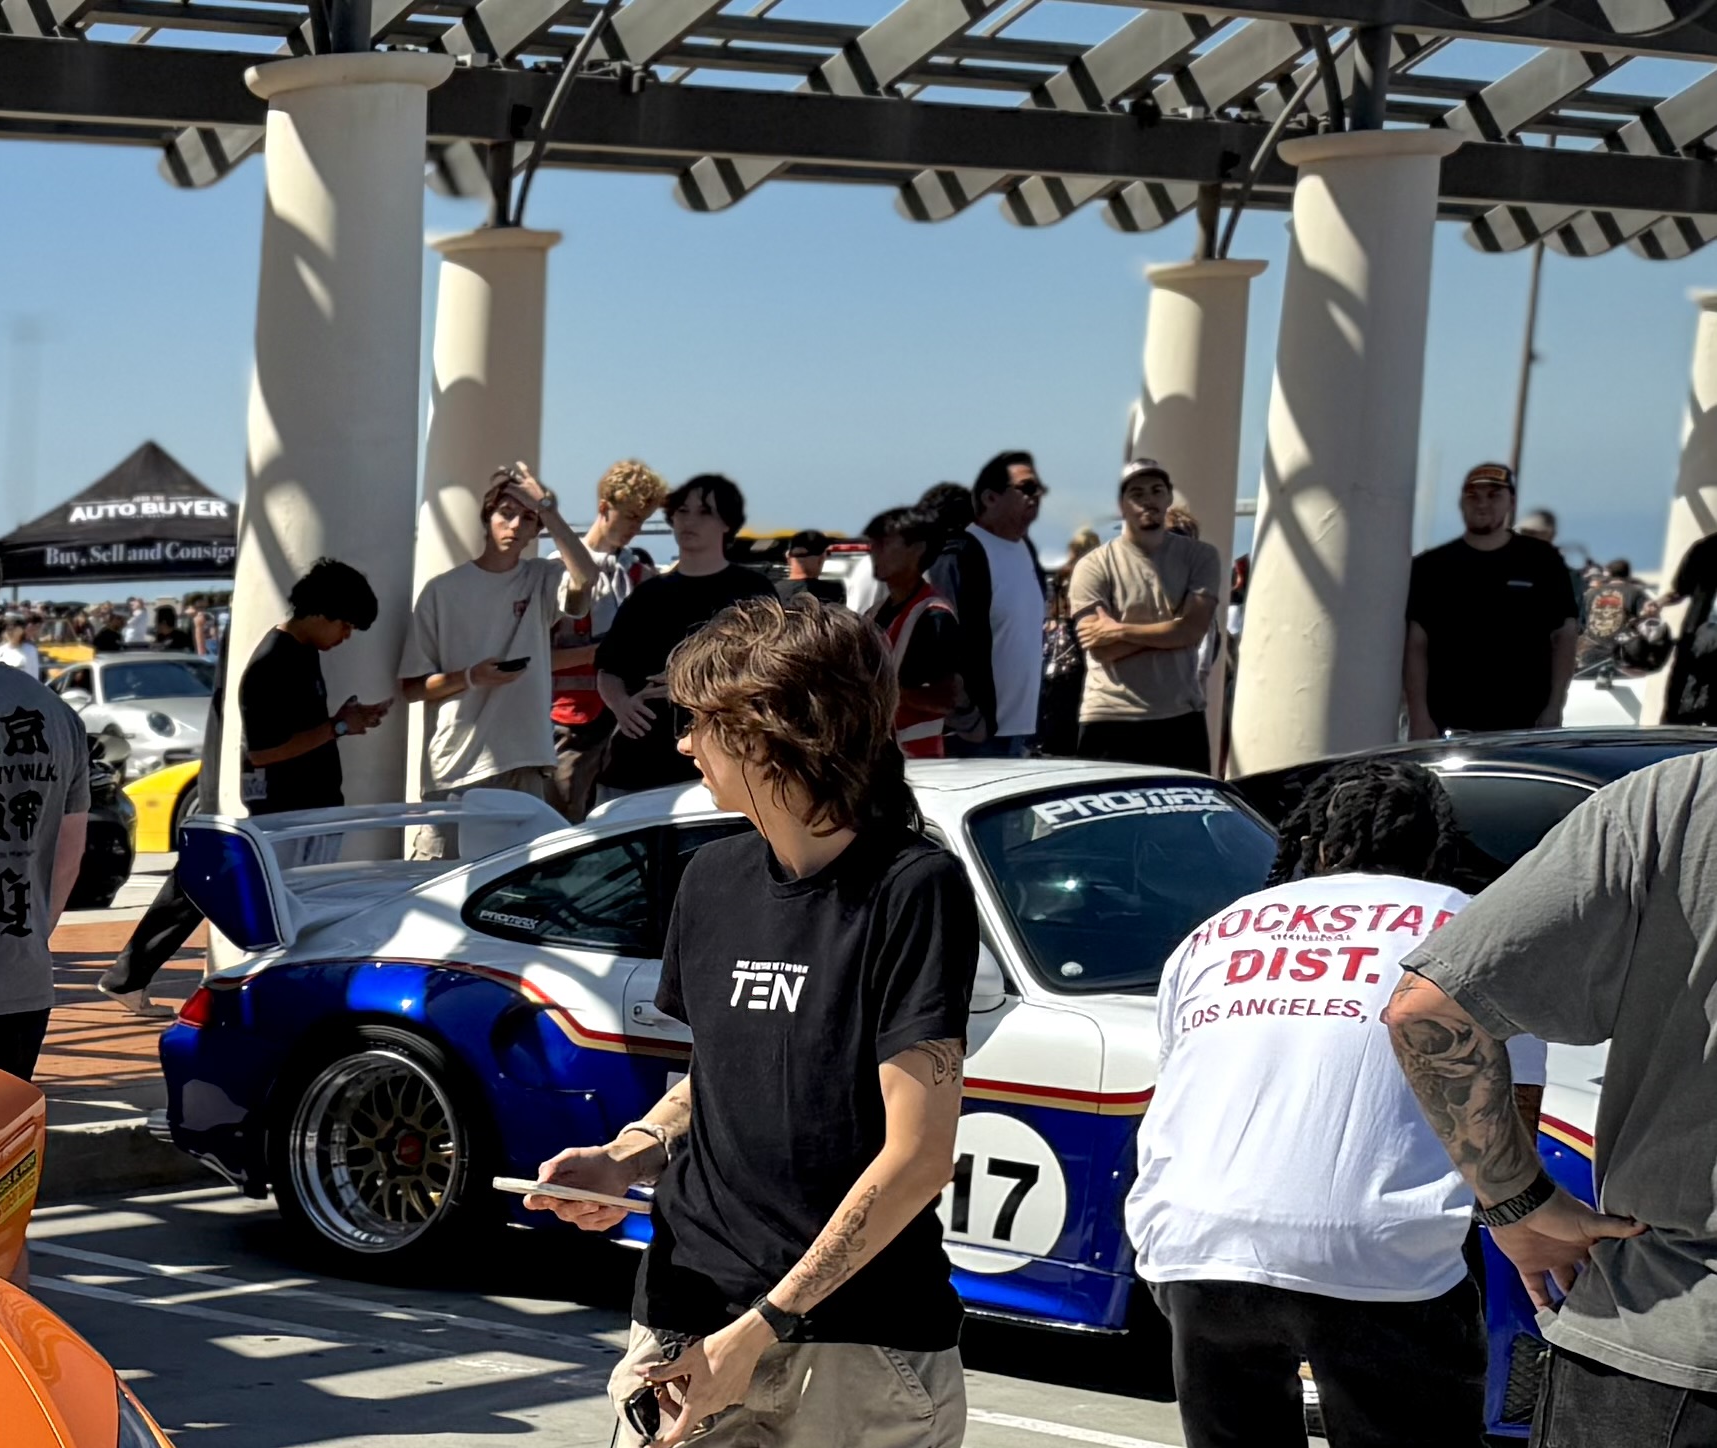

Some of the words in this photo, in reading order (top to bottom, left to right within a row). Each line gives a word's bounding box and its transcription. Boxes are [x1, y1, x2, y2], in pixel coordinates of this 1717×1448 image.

[69, 503, 137, 523] AUTO
[140, 501, 228, 518] BUYER
[90, 543, 124, 562] Sell
[127, 542, 163, 562] and
[1223, 946, 1381, 986] DIST.
[730, 969, 806, 1013] TEN
[1180, 1003, 1220, 1034] LOS
[1225, 997, 1369, 1024] ANGELES,
[950, 1153, 1041, 1242] 17
